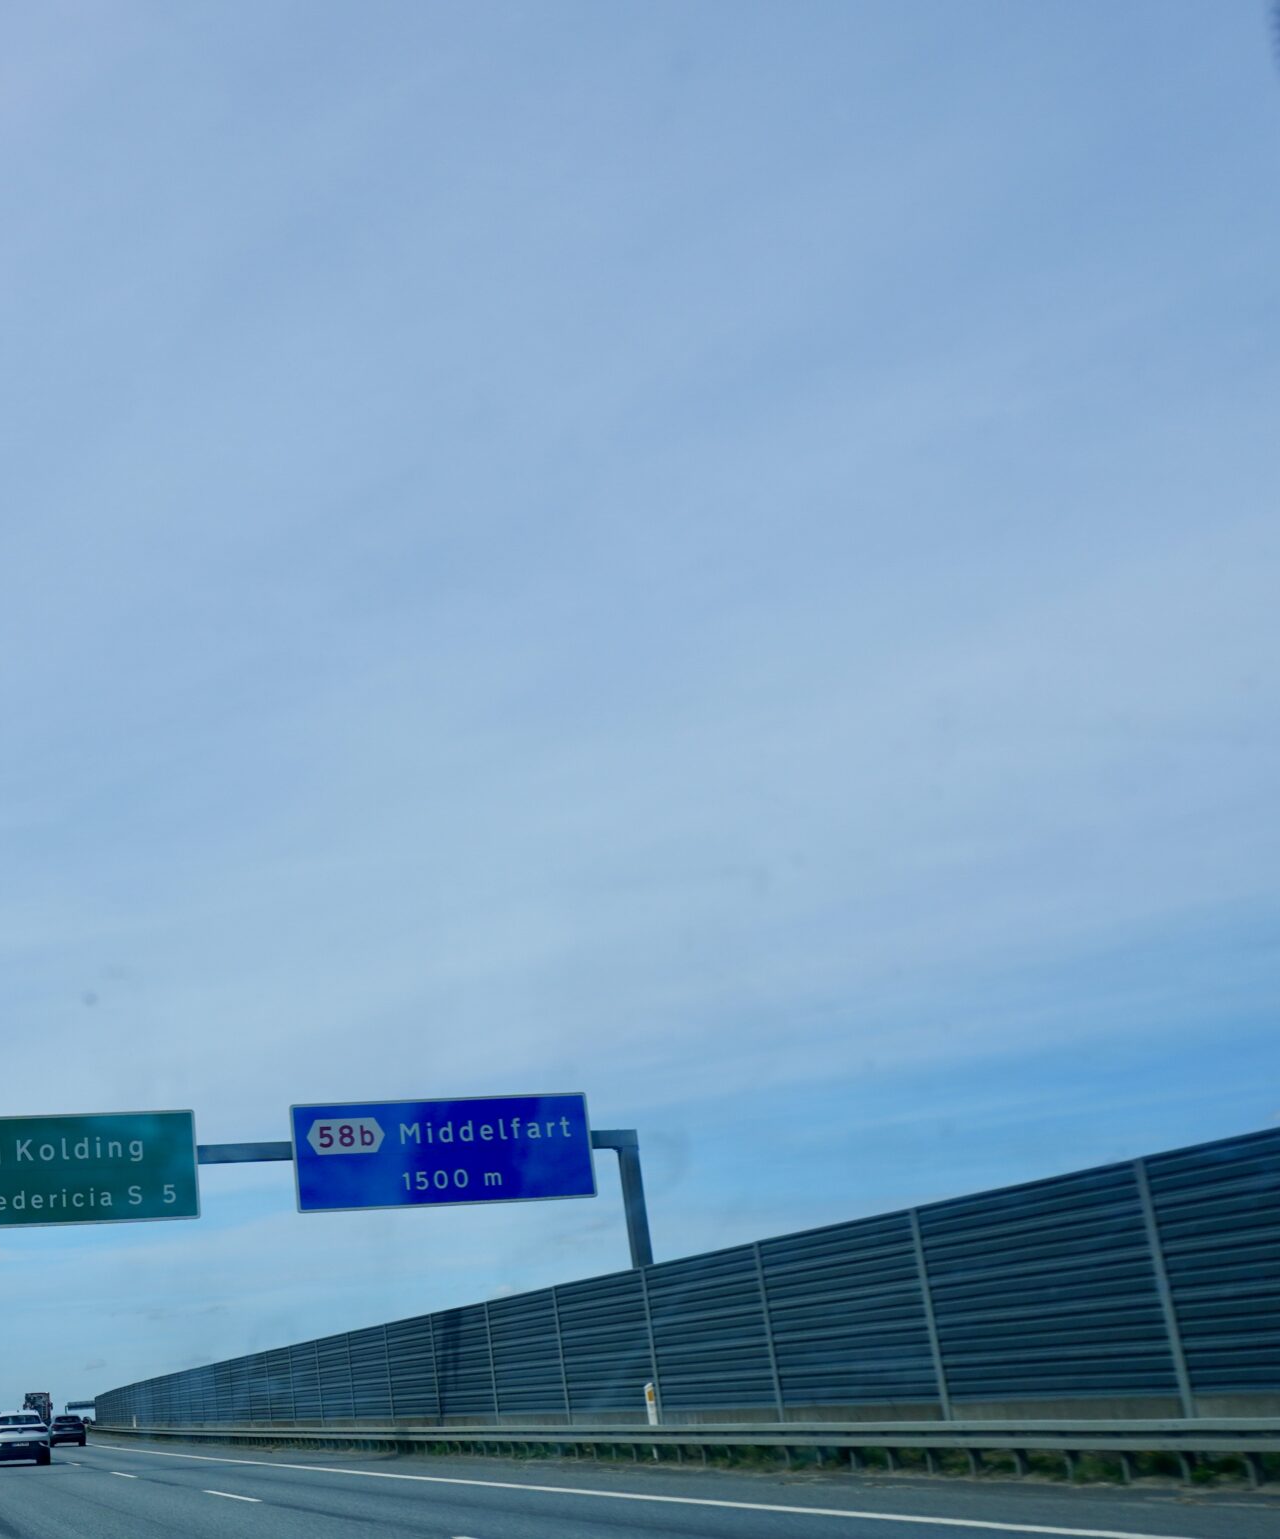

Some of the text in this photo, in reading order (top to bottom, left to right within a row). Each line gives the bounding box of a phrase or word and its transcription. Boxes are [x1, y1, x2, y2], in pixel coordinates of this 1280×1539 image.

[319, 1116, 572, 1149] 58b Middelfart
[16, 1136, 144, 1162] Kolding
[402, 1168, 502, 1191] 1500 m
[127, 1185, 143, 1205] S
[163, 1183, 177, 1204] 5
